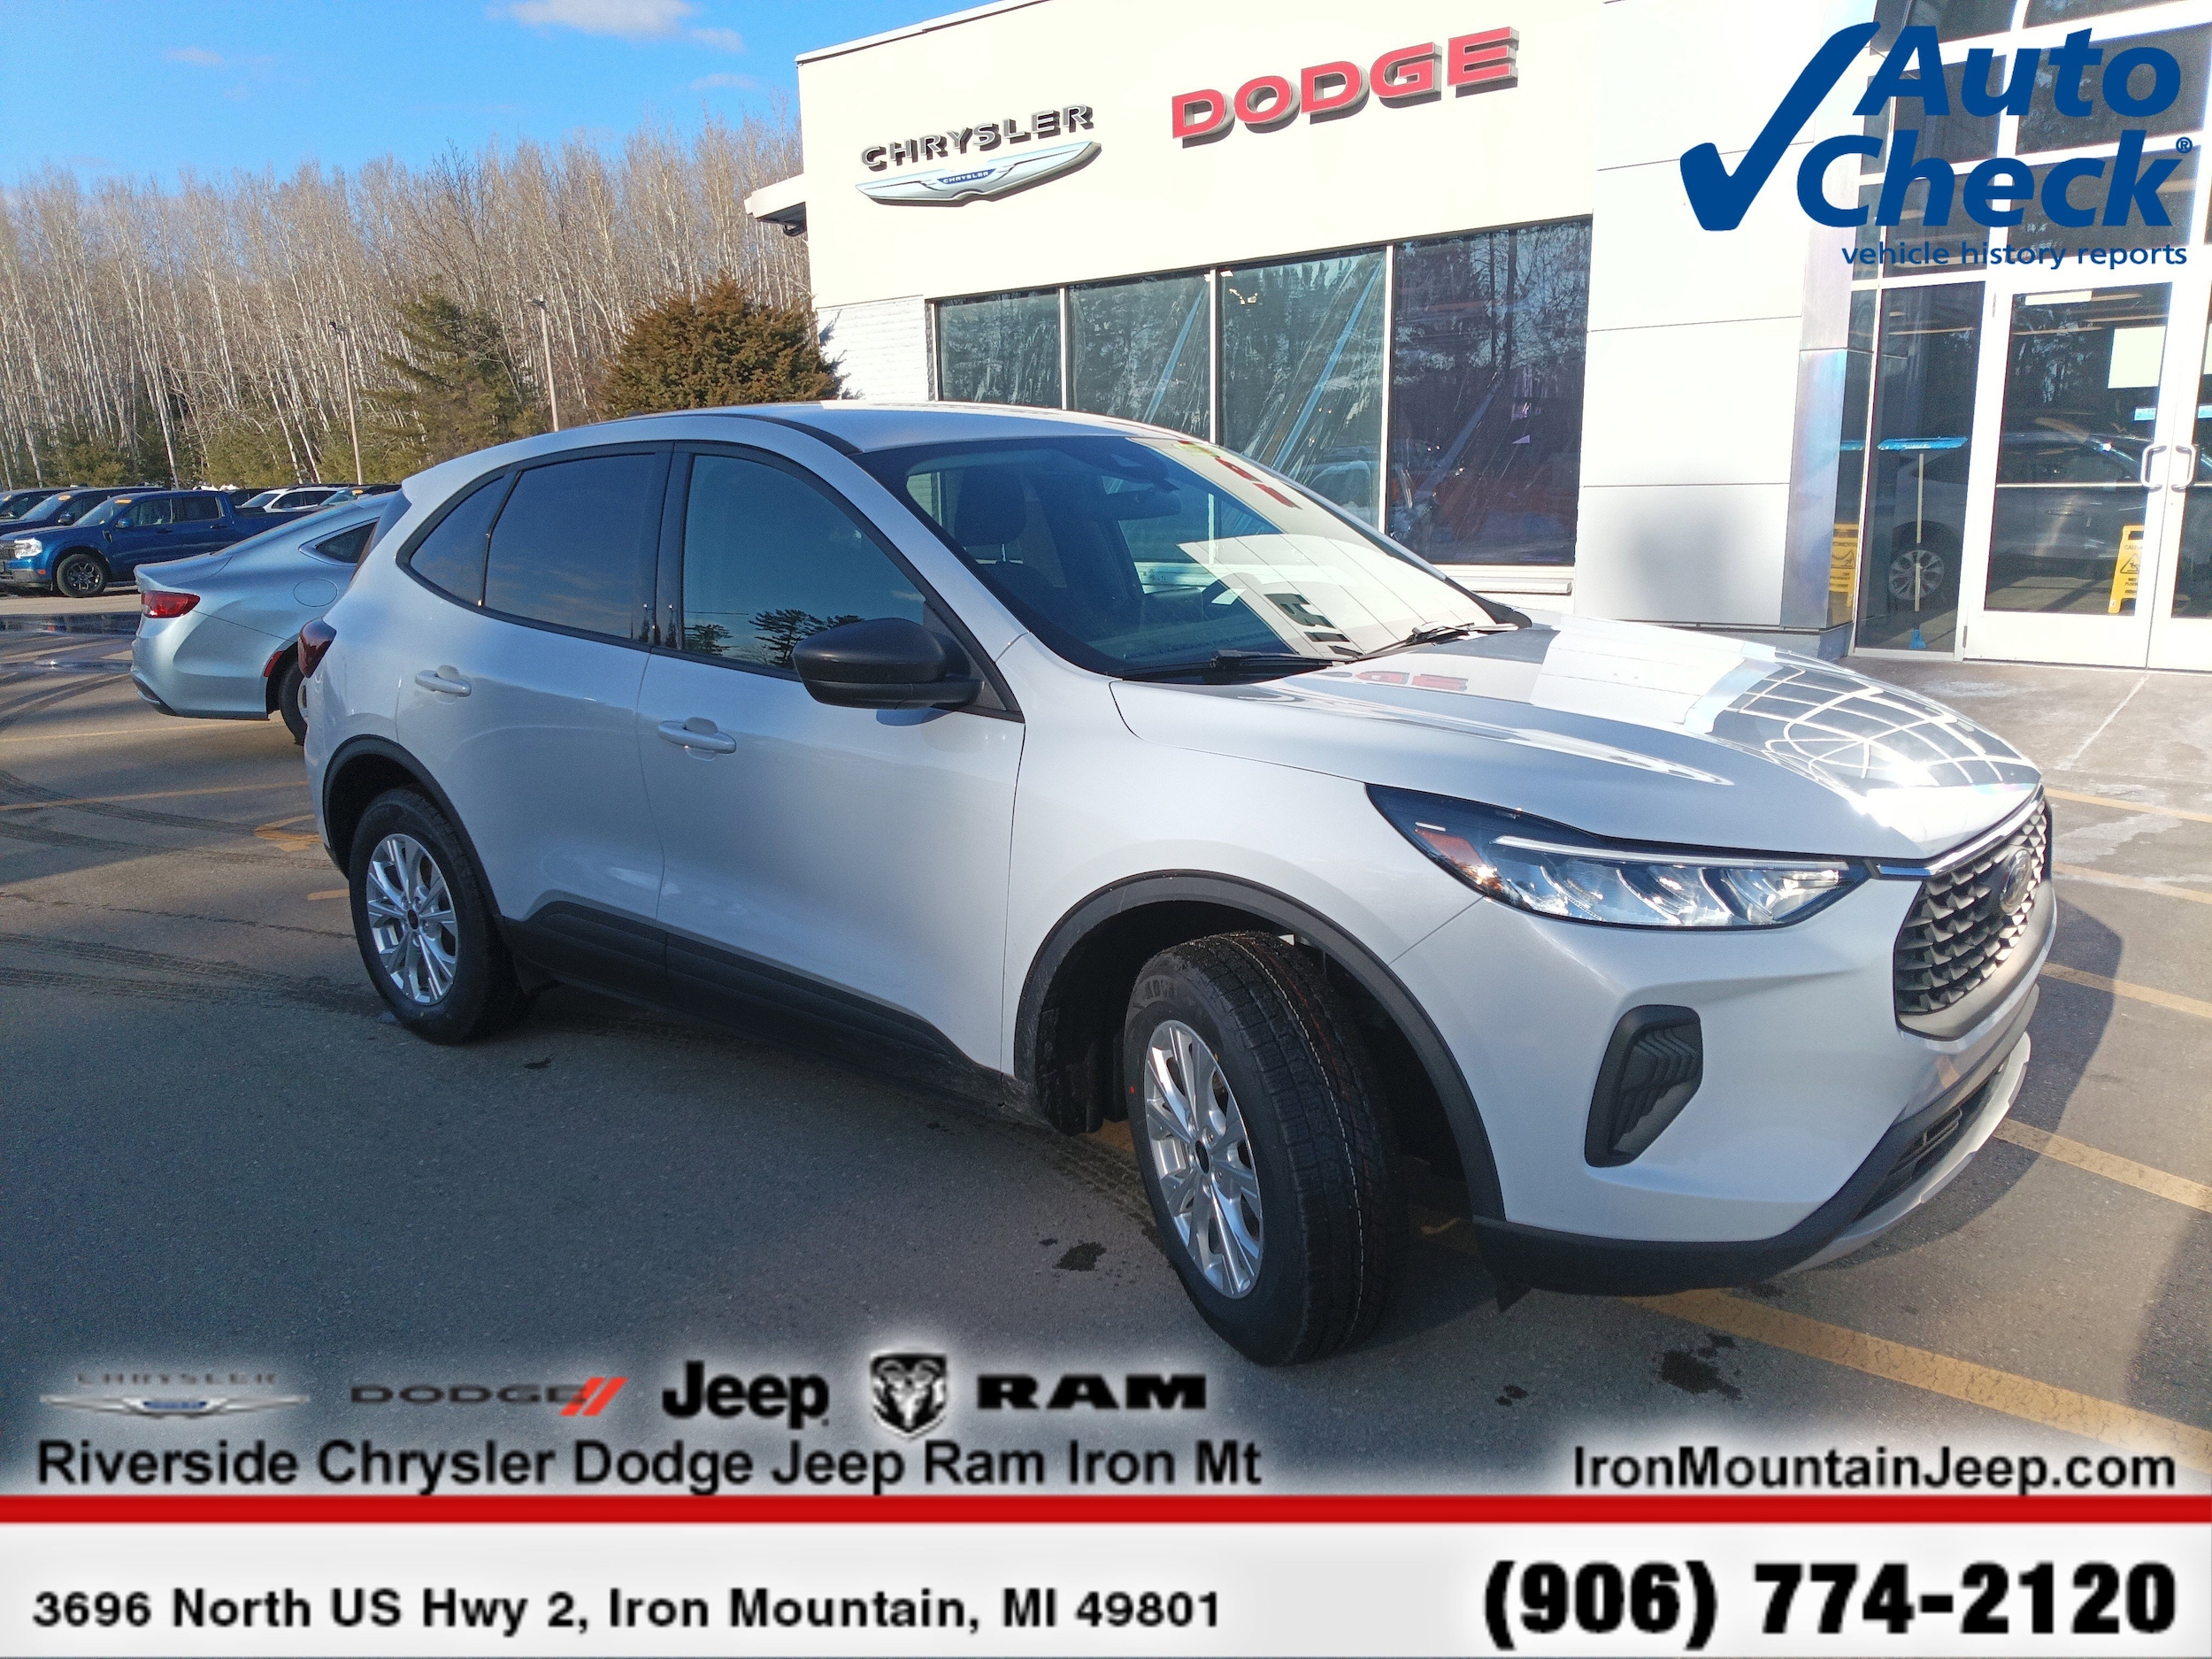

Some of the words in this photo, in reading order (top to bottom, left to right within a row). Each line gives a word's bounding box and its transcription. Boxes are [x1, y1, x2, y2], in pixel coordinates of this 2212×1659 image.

[1171, 26, 1519, 148] DODGE
[860, 104, 1094, 172] CHRYSLER
[942, 171, 989, 183] CHRYSLER
